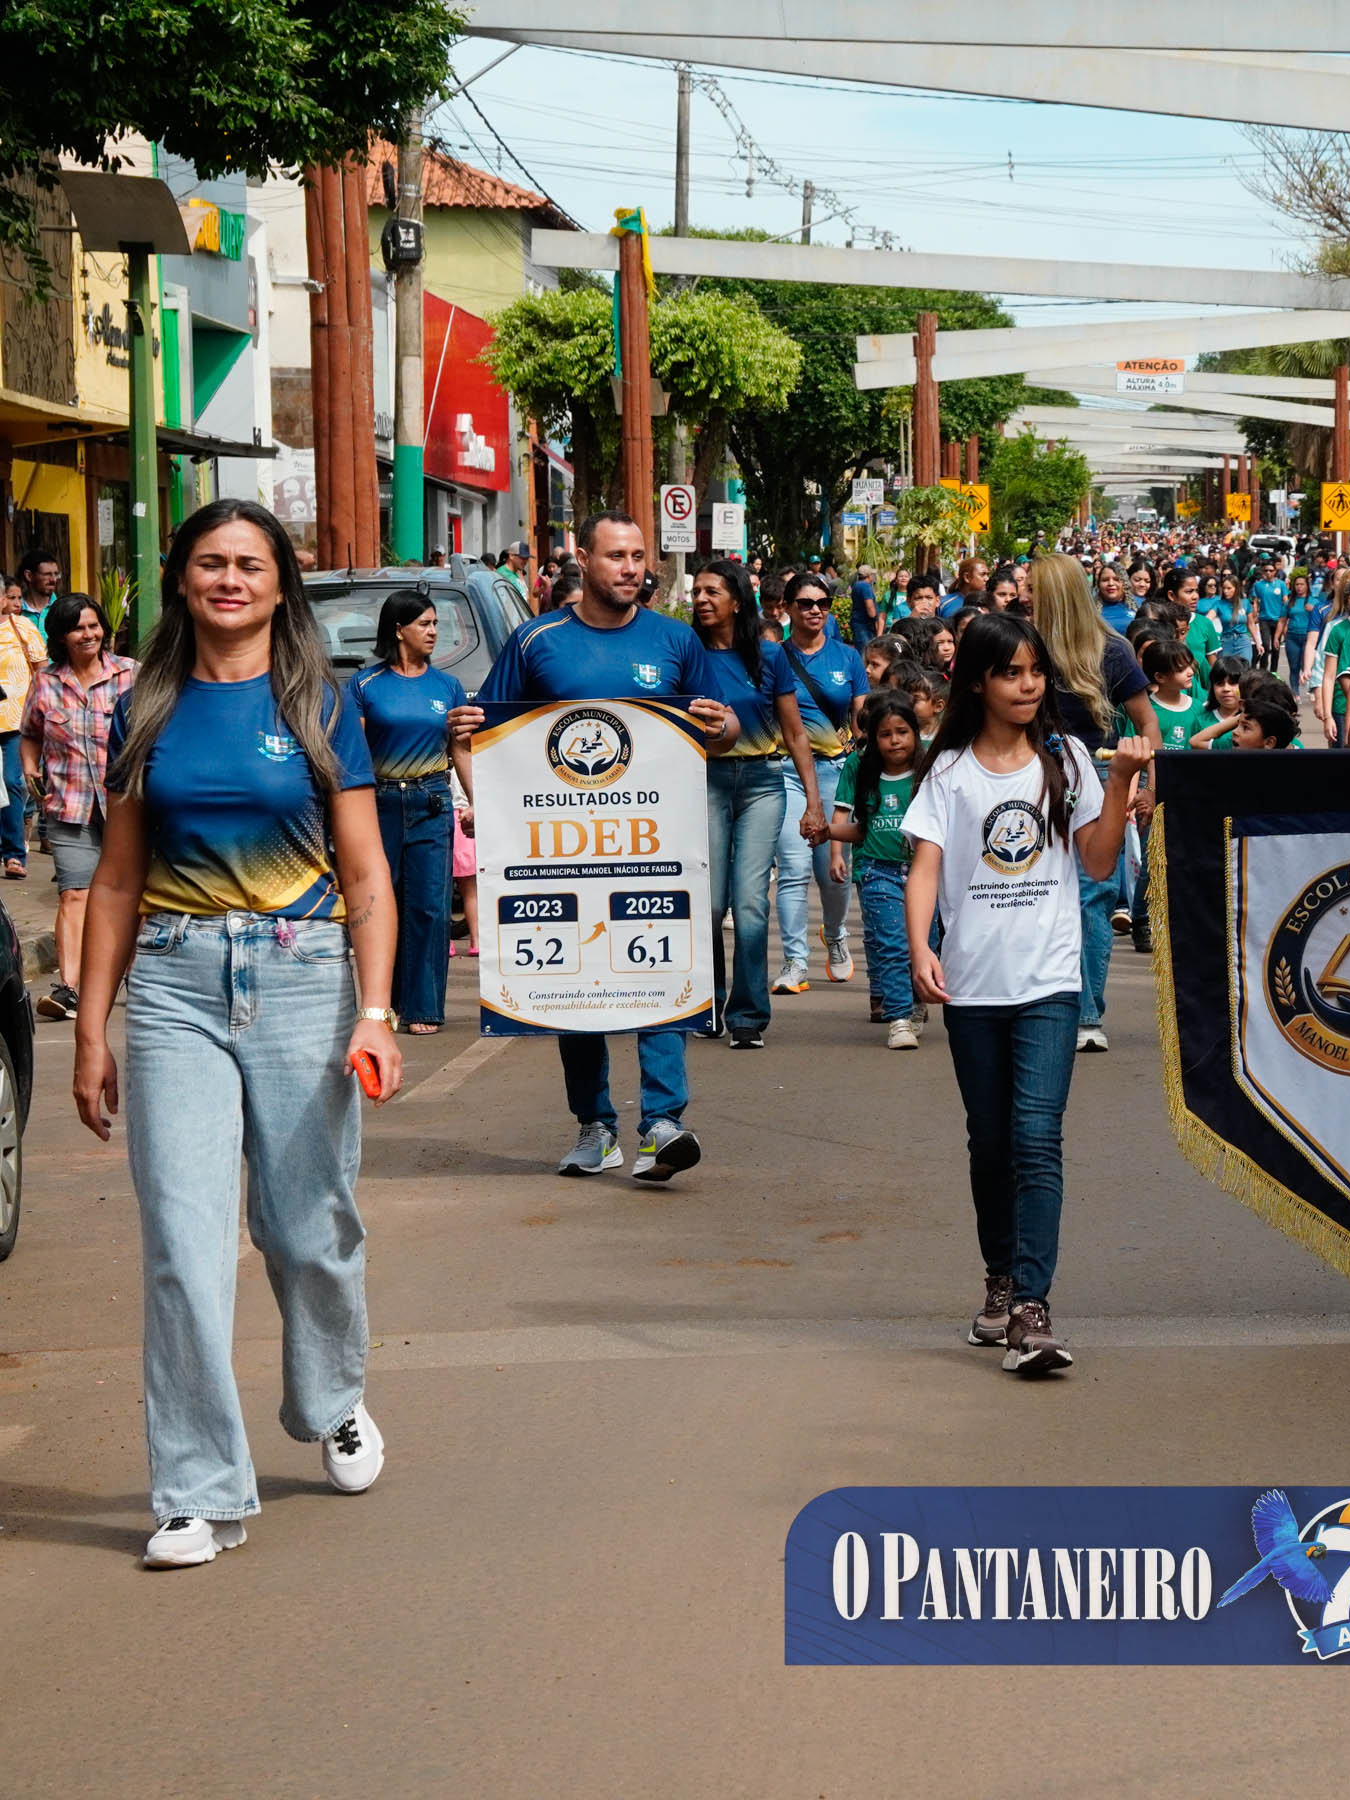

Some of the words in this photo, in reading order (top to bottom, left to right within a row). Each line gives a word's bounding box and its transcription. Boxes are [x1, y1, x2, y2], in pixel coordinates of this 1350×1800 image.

[1124, 359, 1178, 371] ATENÇÃO
[666, 535, 691, 544] MOTOS
[552, 713, 580, 737] ESCOLA
[582, 710, 625, 736] MUNICIPAL
[523, 791, 632, 808] RESULTADOS
[637, 790, 660, 805] DO
[985, 805, 1007, 829] ESCOLA
[526, 817, 661, 859] IDEB
[509, 868, 538, 878] ESCOLA
[539, 867, 581, 876] MUNICIPAL
[581, 866, 613, 876] MANOEL
[613, 865, 639, 875] INÁCIO
[651, 865, 678, 874] FARIAS
[972, 893, 989, 901] com
[990, 889, 1050, 900] responsabilidade
[513, 900, 563, 918] 2023
[625, 897, 675, 915] 2025
[514, 937, 564, 970] 5,2
[627, 935, 673, 969] 6,1
[528, 990, 586, 1001] Construindo
[587, 989, 646, 999] conhecimento
[532, 1000, 607, 1011] responsabilidade
[616, 999, 662, 1009] excelência.
[1294, 1020, 1350, 1062] MANOEL
